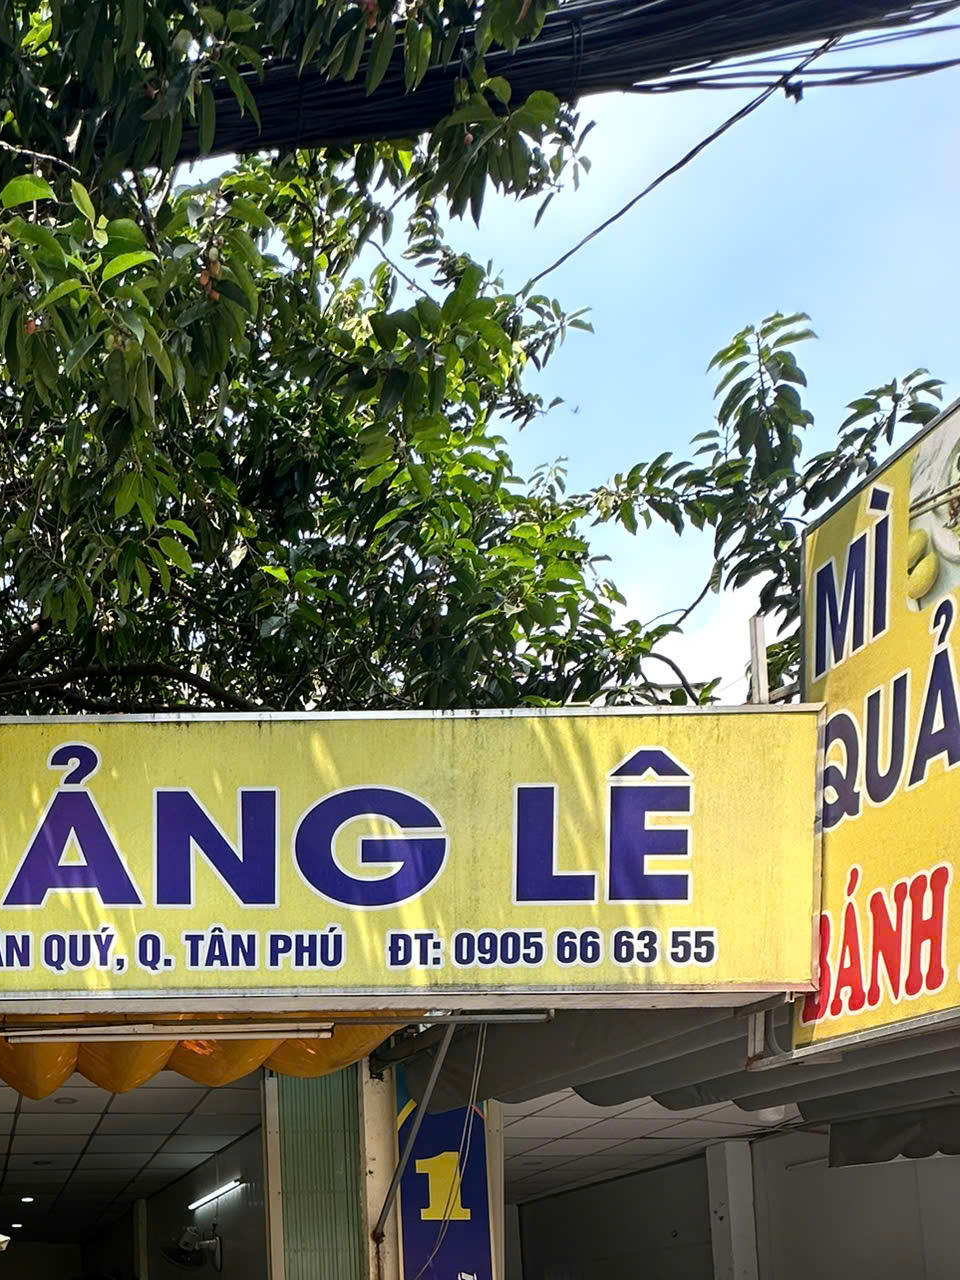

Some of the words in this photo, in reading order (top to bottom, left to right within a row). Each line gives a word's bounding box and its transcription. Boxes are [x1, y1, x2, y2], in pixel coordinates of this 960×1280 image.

[815, 488, 889, 678] MÌ
[515, 748, 692, 901] LÊ
[43, 926, 125, 972] QUÝ,
[138, 932, 172, 968] Q.
[185, 926, 257, 967] TÂN
[269, 927, 343, 967] PHÚ
[388, 932, 442, 967] ĐT:
[453, 931, 543, 966] 0905
[556, 931, 601, 966] 66
[613, 931, 658, 965] 63
[670, 930, 716, 964] 55
[415, 1151, 471, 1220] 1
